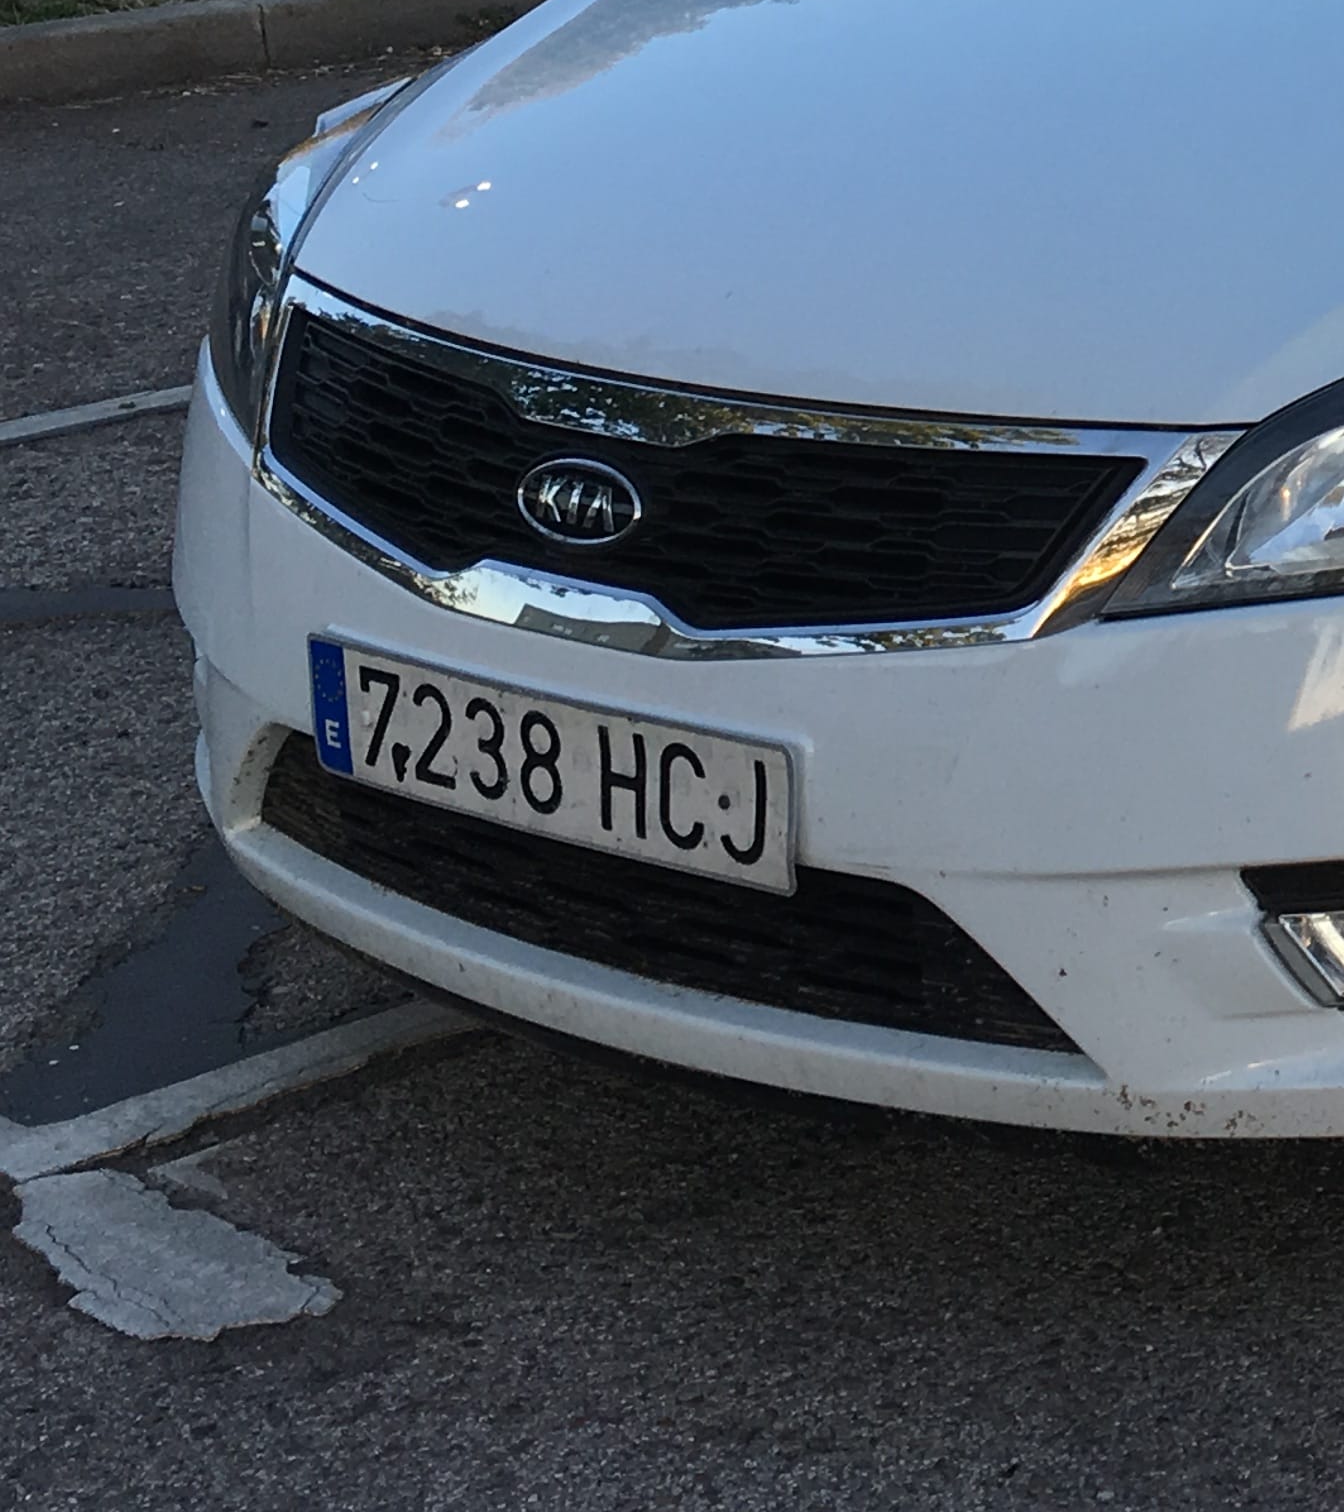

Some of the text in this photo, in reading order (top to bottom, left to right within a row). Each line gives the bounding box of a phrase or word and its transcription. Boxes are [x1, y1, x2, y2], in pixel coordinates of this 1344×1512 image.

[536, 474, 615, 533] KIA
[325, 665, 766, 866] E 7238 HCJ
